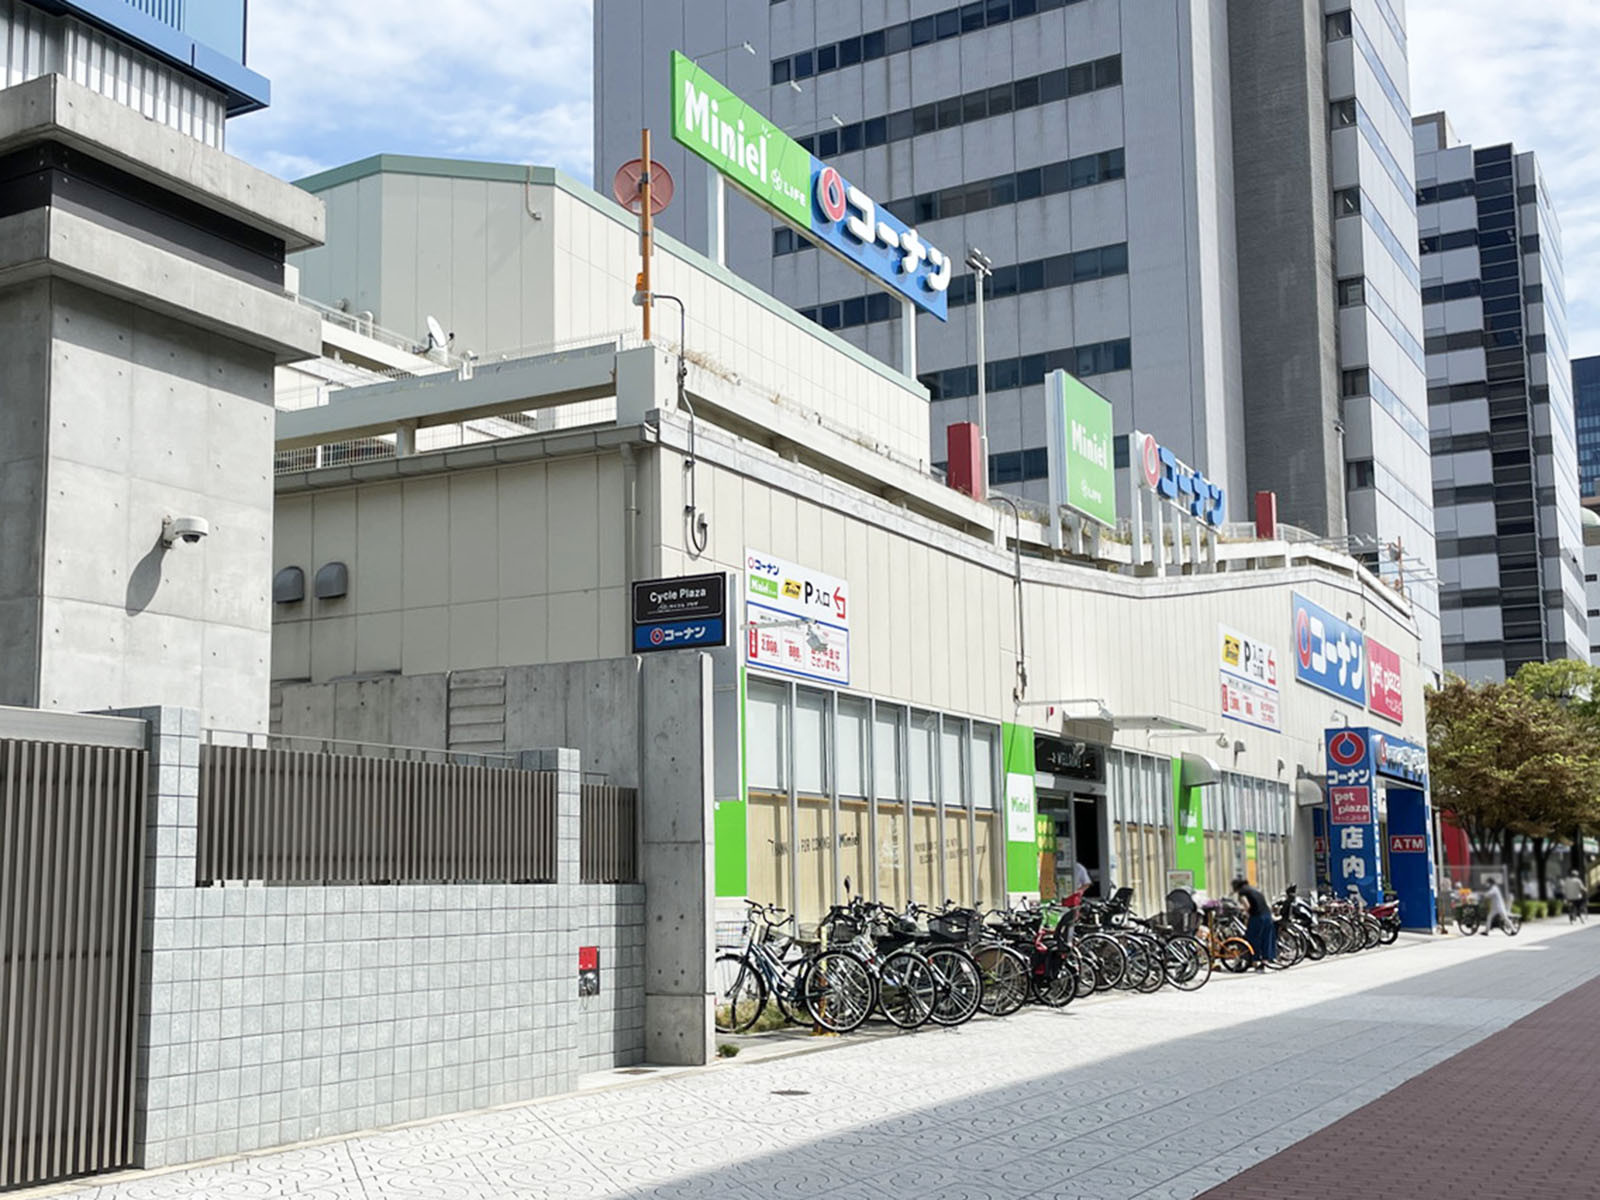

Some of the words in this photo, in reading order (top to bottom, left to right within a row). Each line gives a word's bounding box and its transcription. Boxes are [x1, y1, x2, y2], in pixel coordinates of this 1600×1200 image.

[684, 79, 768, 185] Miniel
[847, 186, 951, 292] コーナン
[1071, 419, 1107, 471] Miniel
[1157, 446, 1225, 528] コーナン
[754, 559, 779, 576] コーナン
[649, 590, 678, 604] Cycle
[679, 588, 706, 599] Plaza
[804, 581, 813, 604] P
[815, 588, 830, 608] 入口
[664, 626, 706, 641] コーナン
[1243, 639, 1251, 672] P
[1310, 616, 1363, 690] コーナン
[1327, 768, 1370, 785] コーナン
[1338, 803, 1369, 816] plaza
[1393, 838, 1424, 850] ATM
